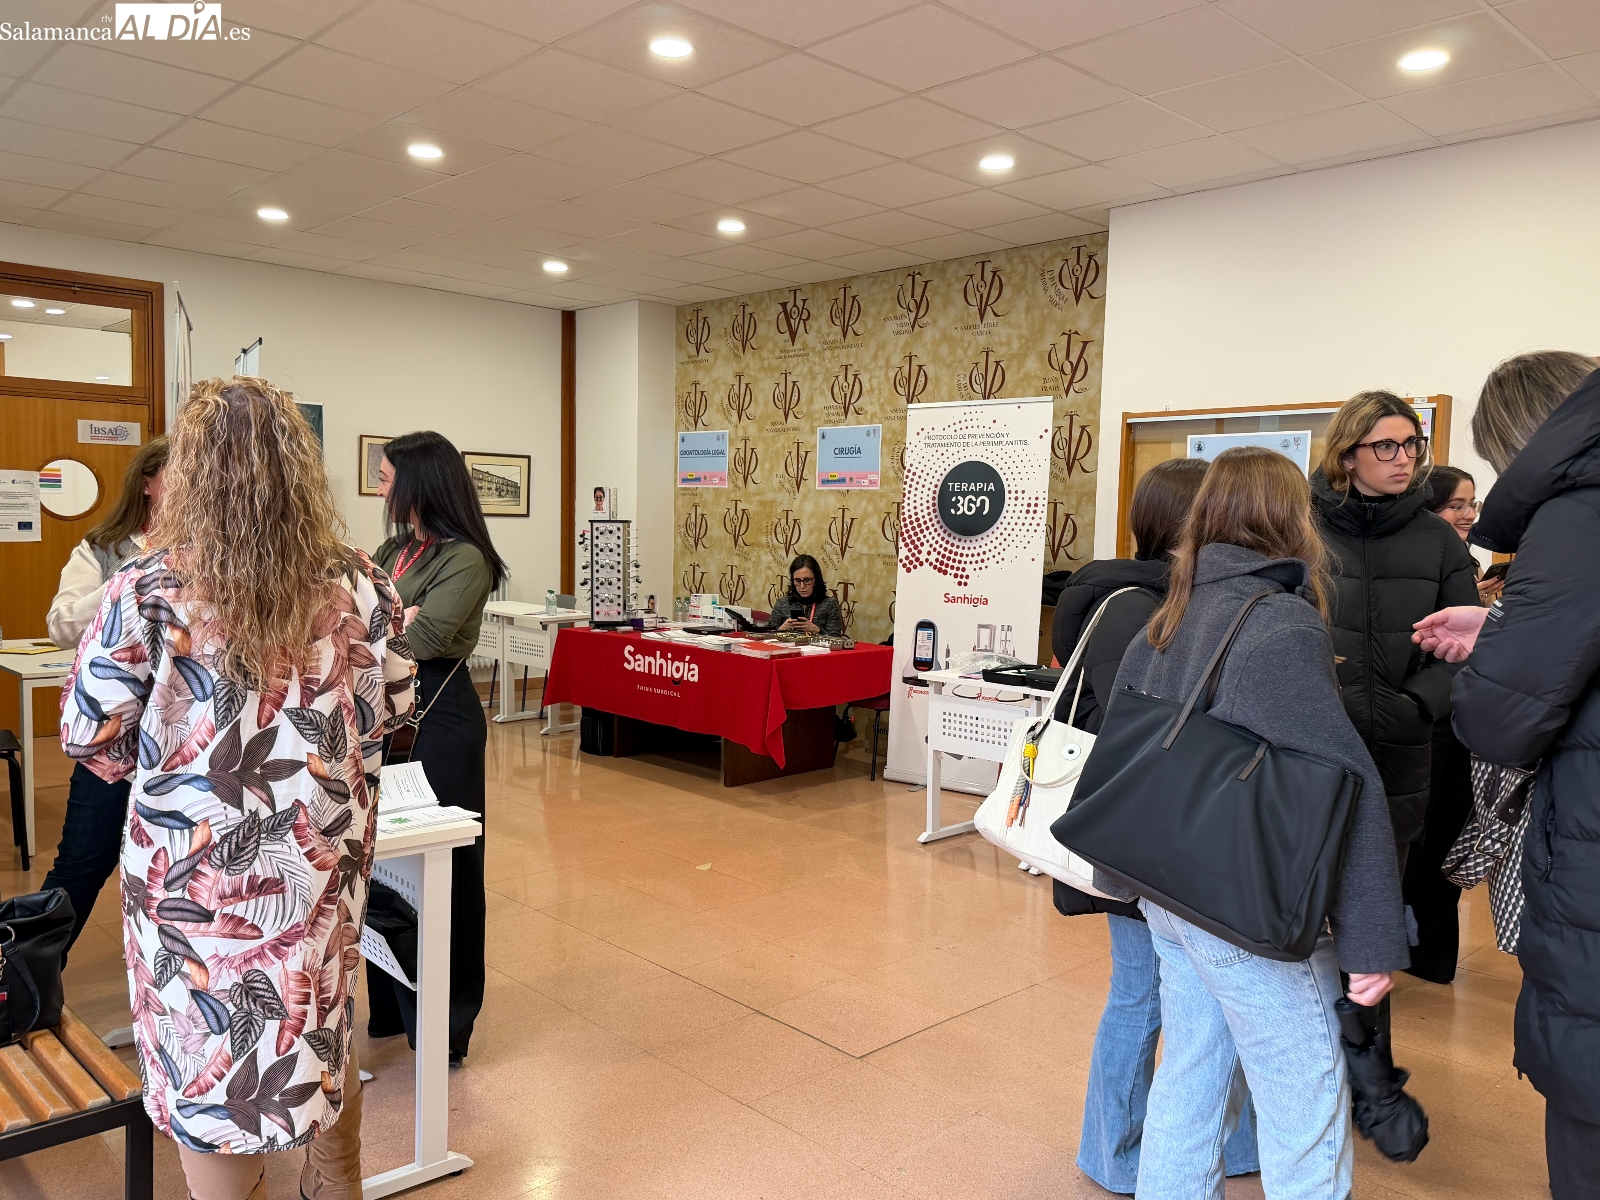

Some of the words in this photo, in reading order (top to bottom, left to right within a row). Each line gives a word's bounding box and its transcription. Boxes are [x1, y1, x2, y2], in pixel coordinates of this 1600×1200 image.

[924, 433, 959, 441] PROTOCOLO
[967, 431, 1005, 440] PREVENCIÓN
[680, 447, 711, 456] ODONTOLOGÍA
[833, 443, 862, 456] CIRUGÍA
[924, 441, 962, 449] TRATAMIENTO
[947, 482, 995, 492] TERAPIA
[950, 494, 990, 516] 360
[943, 592, 989, 608] Sanhigía
[623, 644, 699, 685] Sanhigía
[636, 684, 653, 692] THINK
[653, 687, 681, 698] SURGICAL
